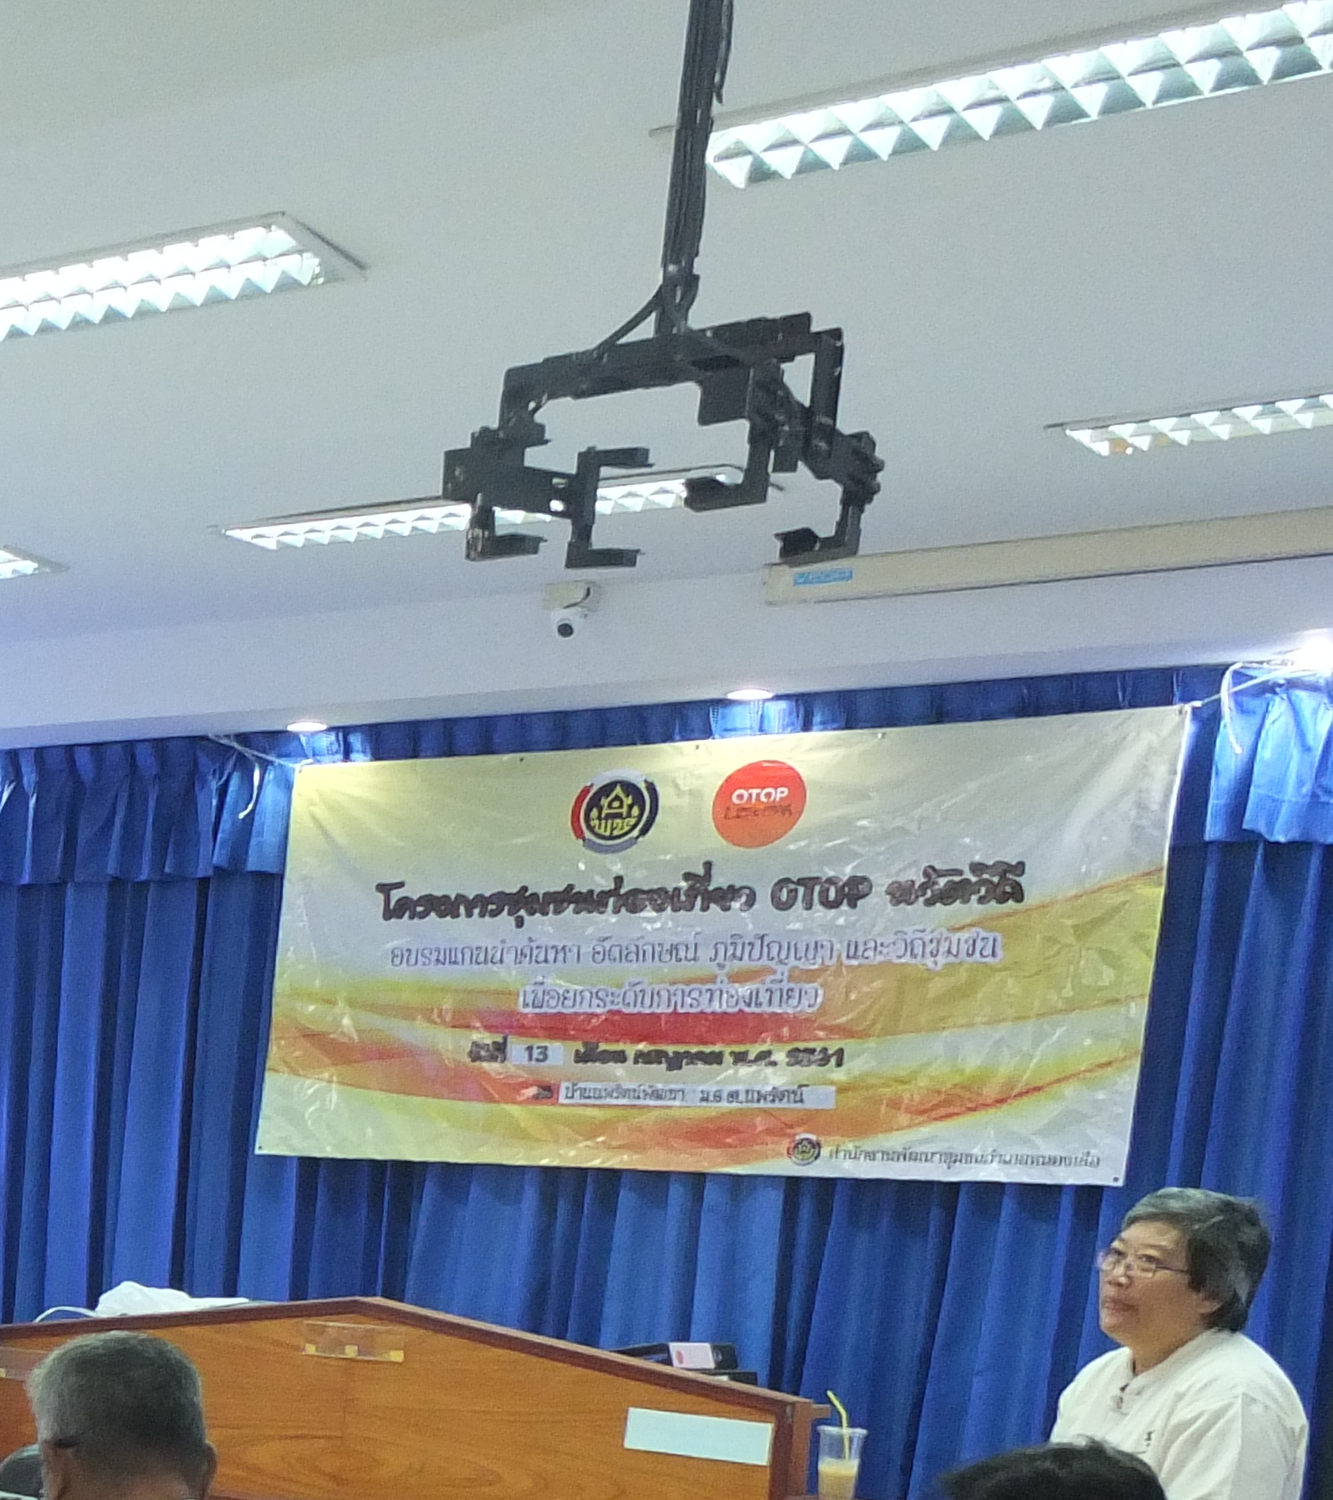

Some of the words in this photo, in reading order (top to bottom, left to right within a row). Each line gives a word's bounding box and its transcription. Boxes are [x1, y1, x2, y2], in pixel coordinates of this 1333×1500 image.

[731, 786, 789, 804] OTOP
[769, 874, 873, 912] OTOP
[591, 932, 699, 965] อัตลักษณ์
[709, 932, 835, 968] ภูมิปัญญา
[521, 971, 821, 1011] เพื่อยกระดับการท่องเที่ยว
[523, 1045, 549, 1063] 13
